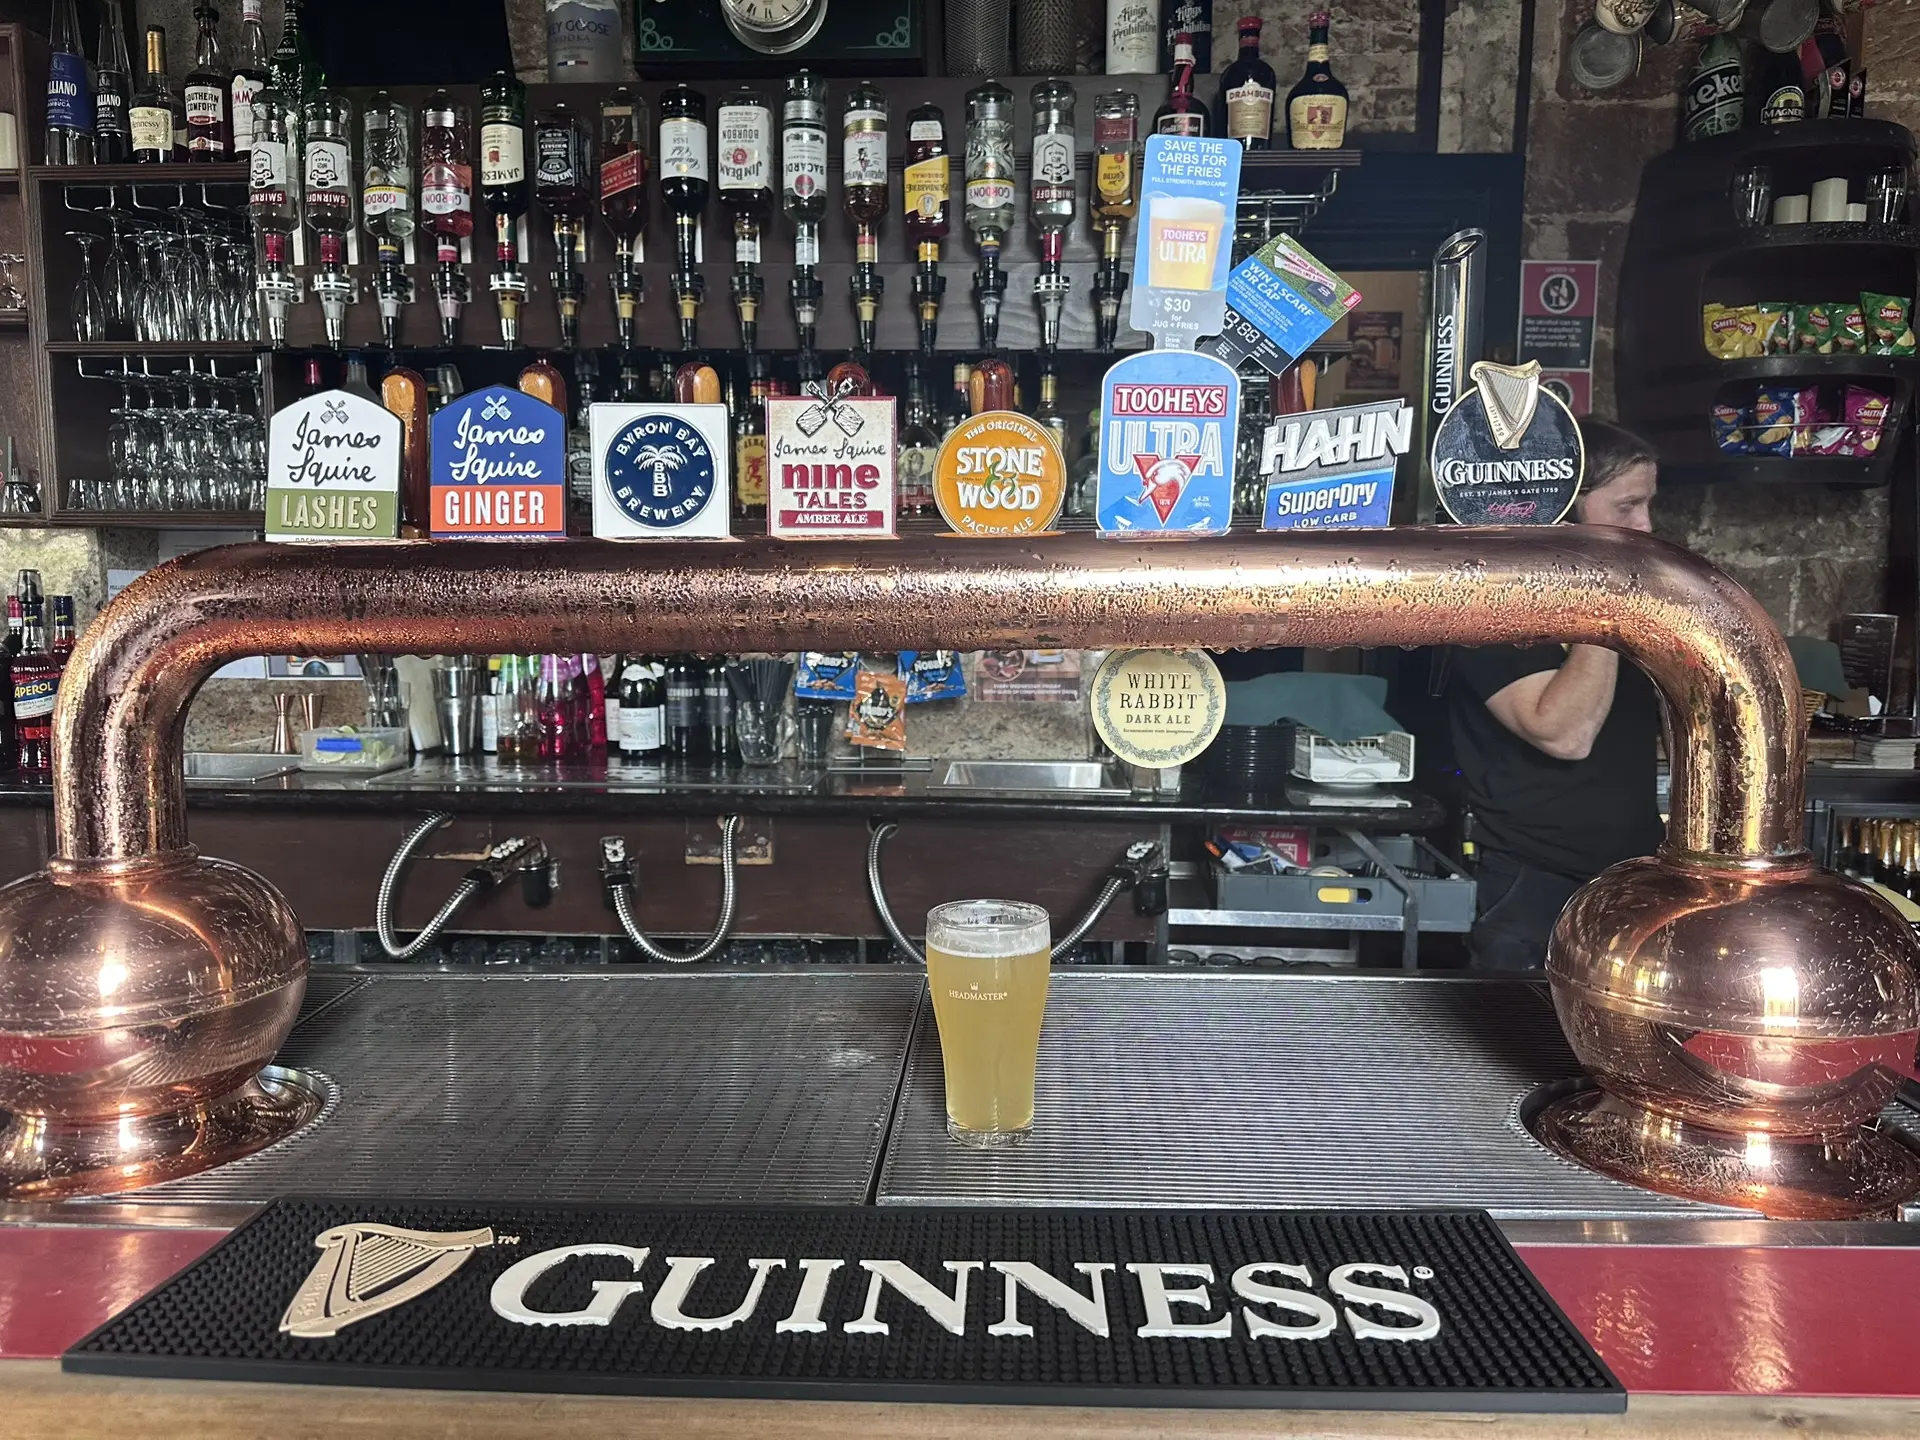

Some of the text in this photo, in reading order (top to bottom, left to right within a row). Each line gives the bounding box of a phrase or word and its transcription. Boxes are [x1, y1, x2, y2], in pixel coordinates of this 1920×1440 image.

[565, 20, 611, 36] GOOSE
[1229, 89, 1271, 100] DRAMBUIE
[722, 129, 759, 139] BOURBON
[1157, 151, 1227, 166] CARBS FOR
[1164, 140, 1223, 154] SAVE THE
[720, 161, 762, 180] JIM BEAM
[1161, 164, 1222, 178] THE FRIES
[1163, 229, 1207, 242] TOOHEYS
[1159, 241, 1207, 264] ULTRA
[1241, 269, 1281, 301] OR CAP
[1249, 262, 1272, 283] WIN
[1270, 281, 1280, 291] A
[1278, 288, 1315, 316] SCARF
[1163, 296, 1191, 313] $30
[1152, 320, 1169, 328] JUG
[1176, 321, 1199, 330] FRIES
[1432, 314, 1455, 414] GUINNESS
[1116, 386, 1224, 413] TOOHEYS
[292, 411, 381, 451] James
[453, 408, 545, 450] James
[616, 421, 707, 458] BYRON BAY
[964, 420, 1038, 442] THE ORIGINAL
[1259, 407, 1413, 475] HAHN
[774, 435, 828, 459] James
[833, 437, 886, 460] Squire
[1108, 421, 1223, 476] ULTRA
[287, 446, 376, 487] Squire
[449, 443, 542, 484] Squire
[956, 446, 1045, 478] STONE
[1444, 458, 1574, 485] GUINNESS
[781, 464, 880, 490] nine
[445, 490, 545, 525] GINGER
[617, 485, 706, 520] BREWERY
[793, 491, 867, 509] TALES
[956, 481, 1042, 510] WOOD
[1278, 481, 1378, 515] SuperDry
[281, 494, 378, 530] LASHES
[795, 513, 868, 524] AMBER ALE
[1294, 517, 1320, 528] LOW
[1323, 511, 1357, 524] CARB
[961, 515, 1035, 534] PACIFIC ALE
[14, 682, 53, 699] APEROL
[1127, 672, 1192, 689] WHITE
[1120, 693, 1199, 709] RABBIT
[1126, 714, 1191, 724] DARK ALE
[949, 990, 1005, 1000] HEADMASTER
[490, 1243, 1441, 1342] GUINNESS
